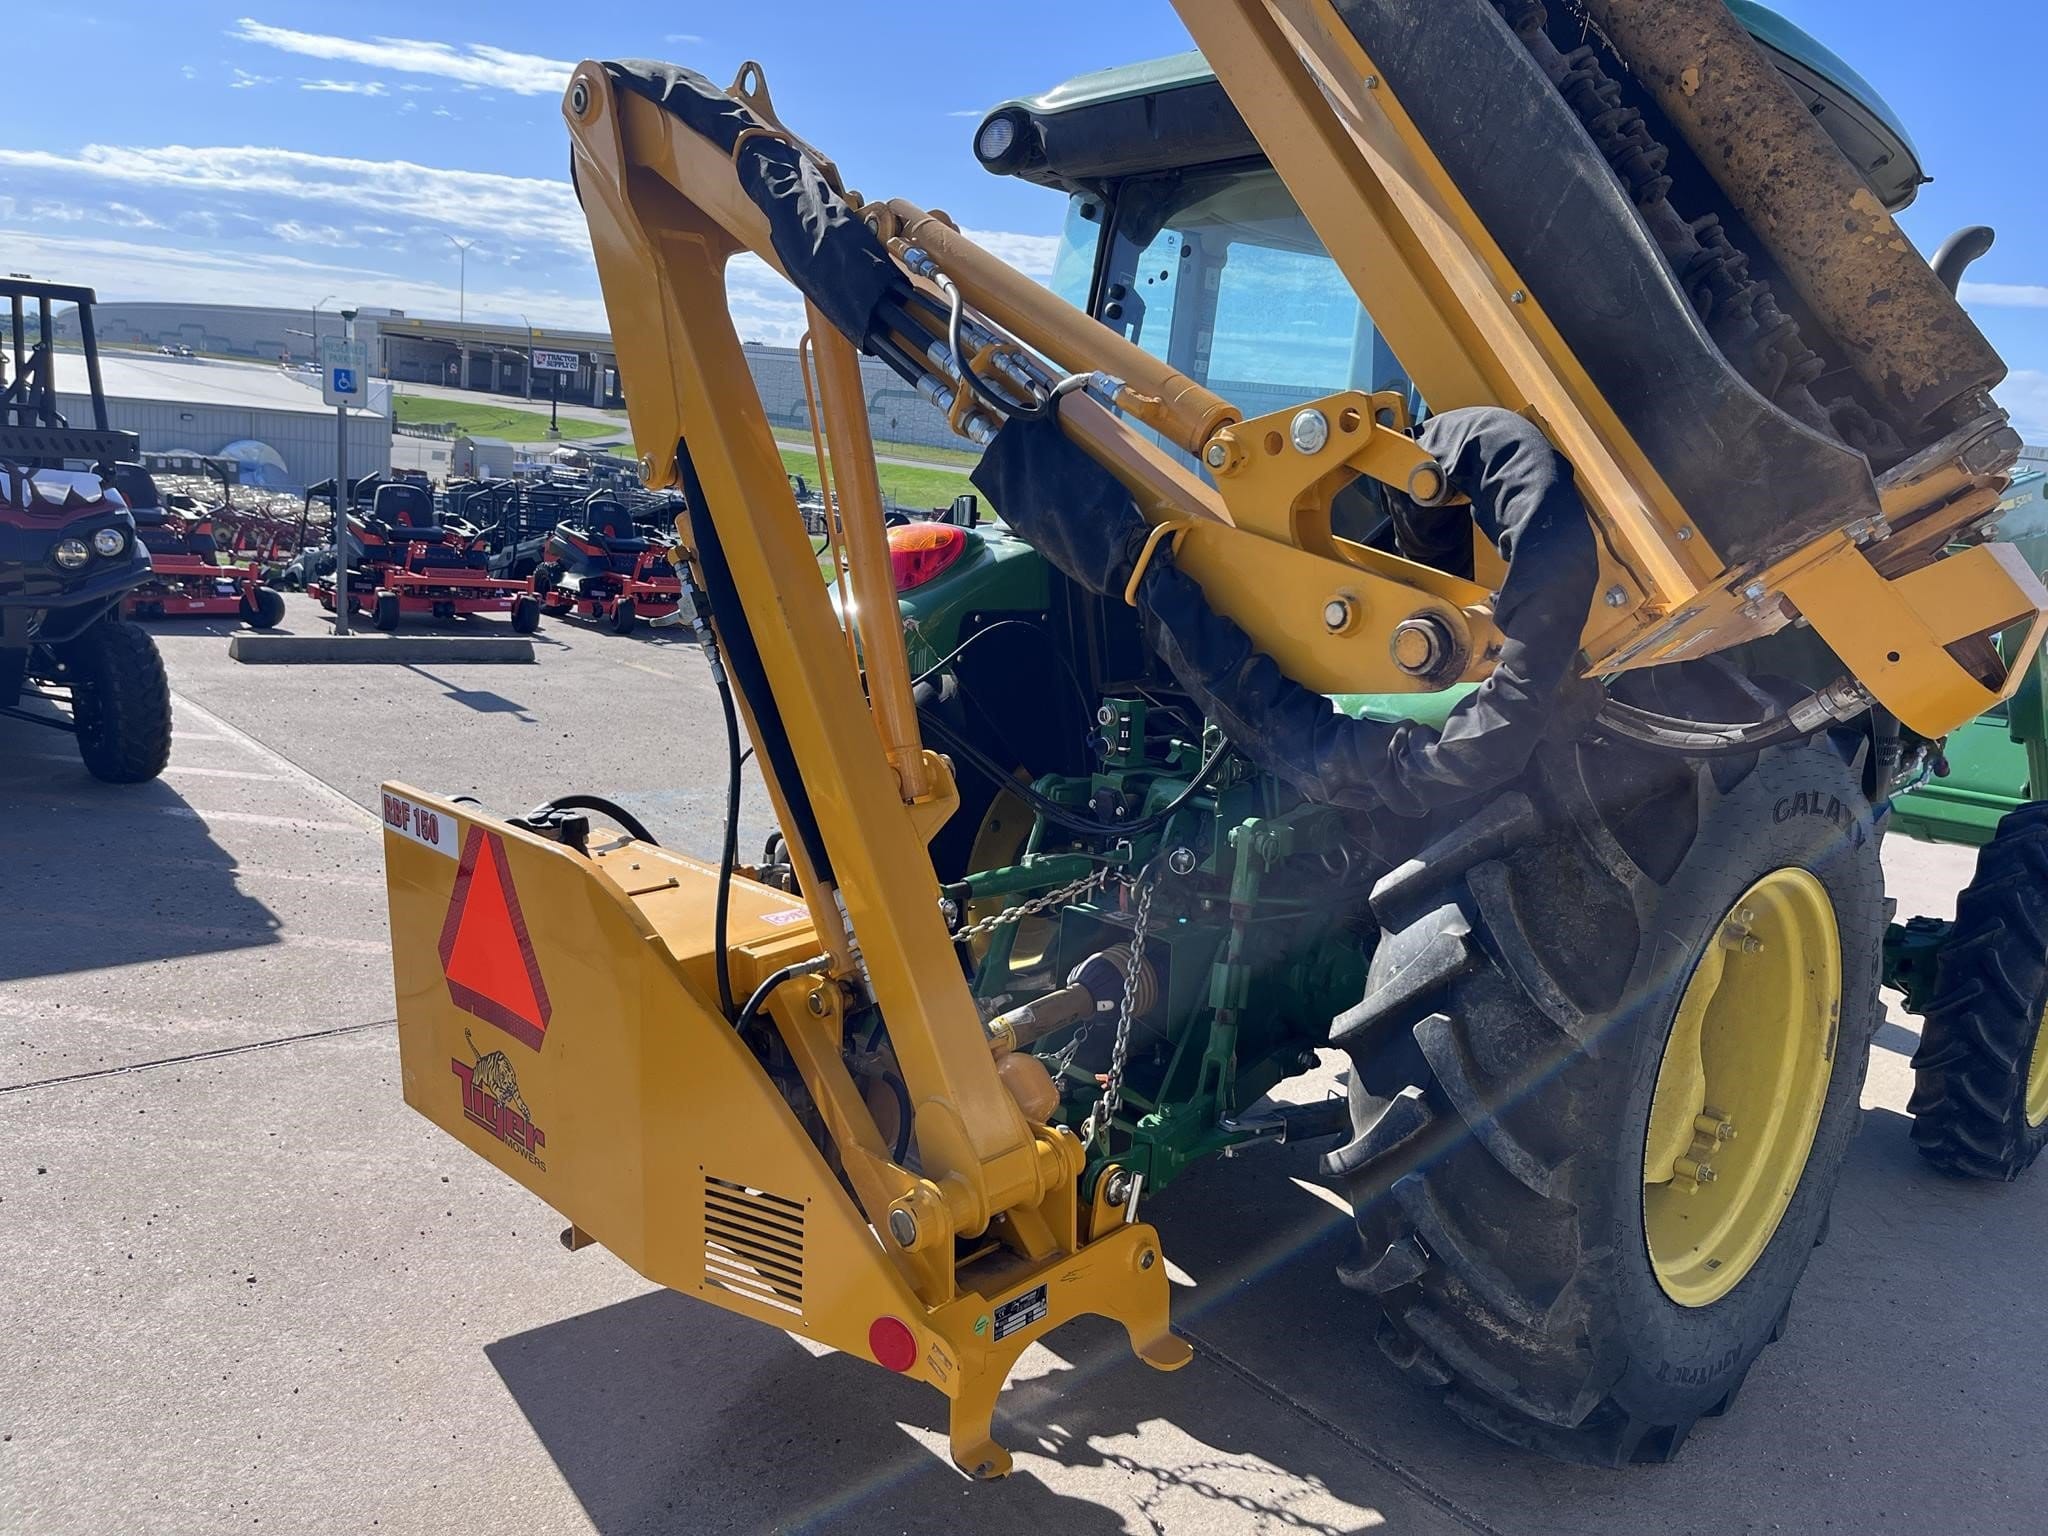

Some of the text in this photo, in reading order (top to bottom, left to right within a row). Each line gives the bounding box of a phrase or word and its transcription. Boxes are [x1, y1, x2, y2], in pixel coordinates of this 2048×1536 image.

[547, 353, 577, 362] TRACTOR
[384, 794, 439, 845] RBF 150
[452, 1057, 545, 1155] Tiger
[504, 1135, 546, 1172] MOWERS
